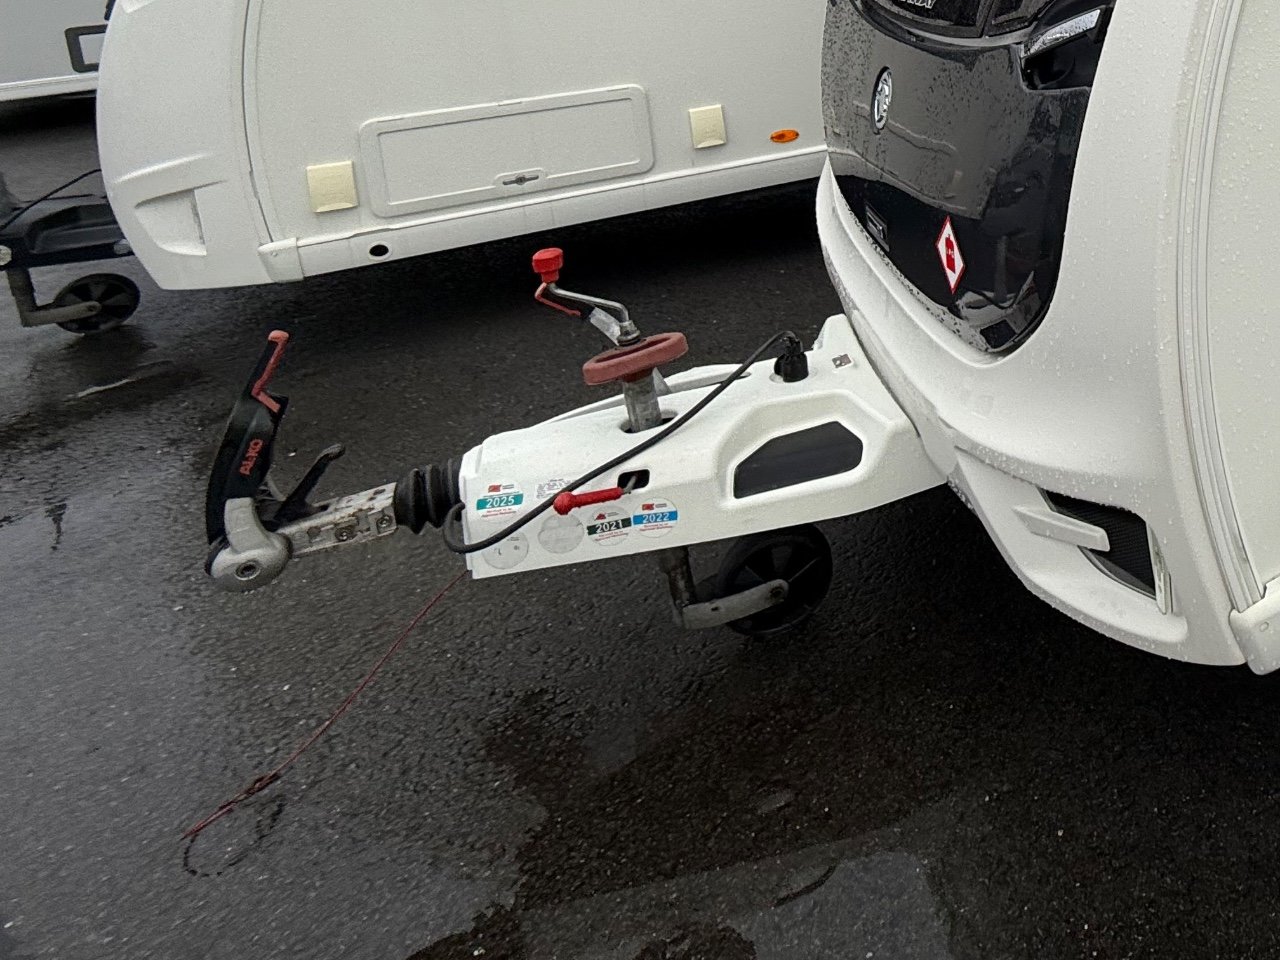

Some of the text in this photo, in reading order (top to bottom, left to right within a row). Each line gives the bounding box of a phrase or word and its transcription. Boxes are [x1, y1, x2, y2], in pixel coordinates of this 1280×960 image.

[485, 495, 515, 508] 2025
[642, 512, 670, 524] 2022
[595, 519, 623, 533] 2021
